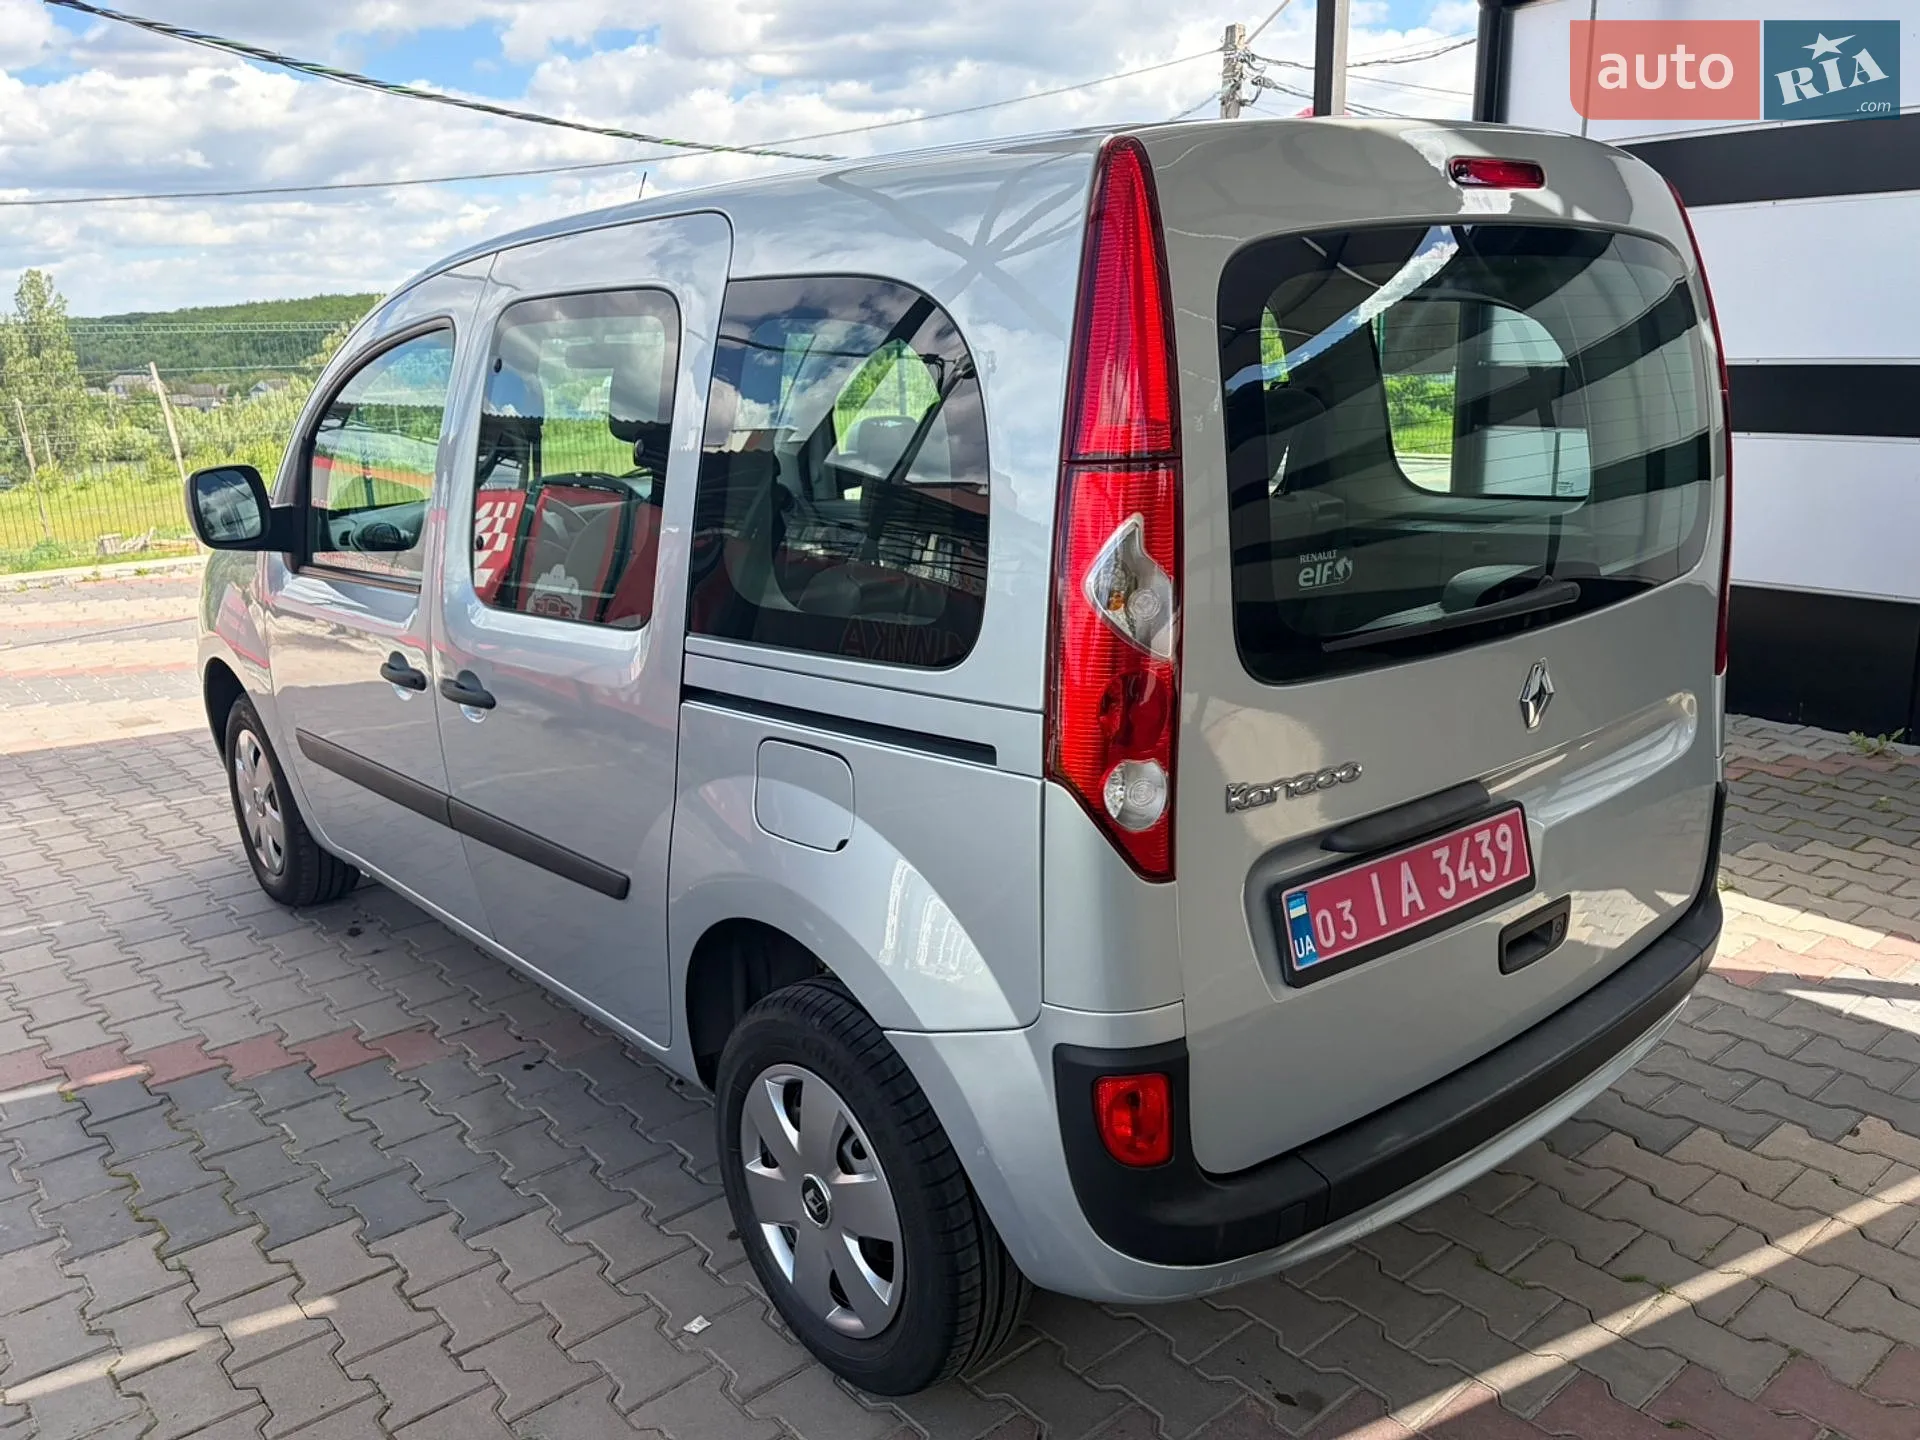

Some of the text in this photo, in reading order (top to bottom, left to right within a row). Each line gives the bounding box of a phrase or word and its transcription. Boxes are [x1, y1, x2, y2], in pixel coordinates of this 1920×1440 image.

[1299, 549, 1338, 564] RENAULT
[1298, 561, 1334, 587] elf
[1225, 761, 1363, 813] Kangoo
[1315, 823, 1513, 949] 03 IA 3439
[1294, 934, 1316, 959] UA
